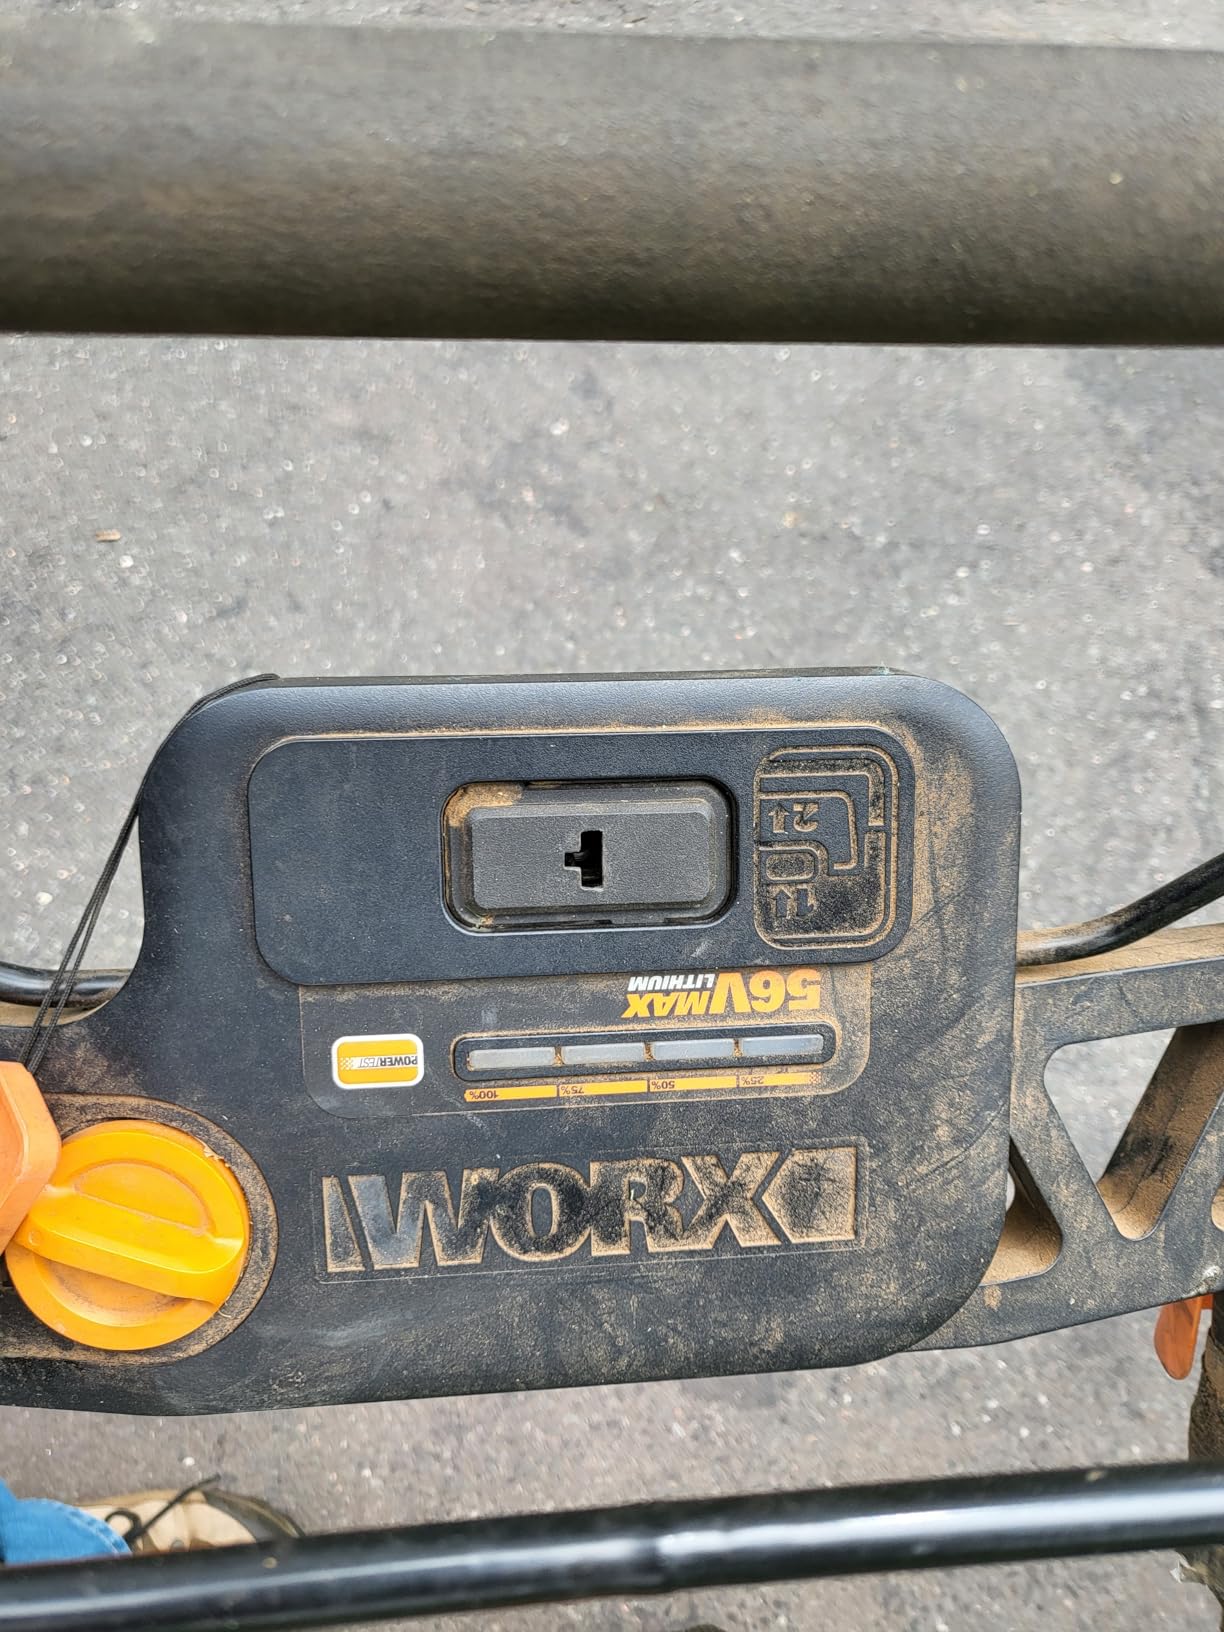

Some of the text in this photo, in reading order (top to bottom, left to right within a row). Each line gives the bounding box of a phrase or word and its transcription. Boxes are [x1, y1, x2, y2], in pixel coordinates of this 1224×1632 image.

[627, 973, 716, 992] LITHIUM
[620, 968, 822, 1019] 56V MAX
[358, 1055, 419, 1068] POWERTEST
[651, 1080, 676, 1090] 50%
[741, 1075, 765, 1085] 25%
[469, 1090, 499, 1100] 100%
[560, 1085, 585, 1095] 75%
[347, 1151, 782, 1271] WORX
